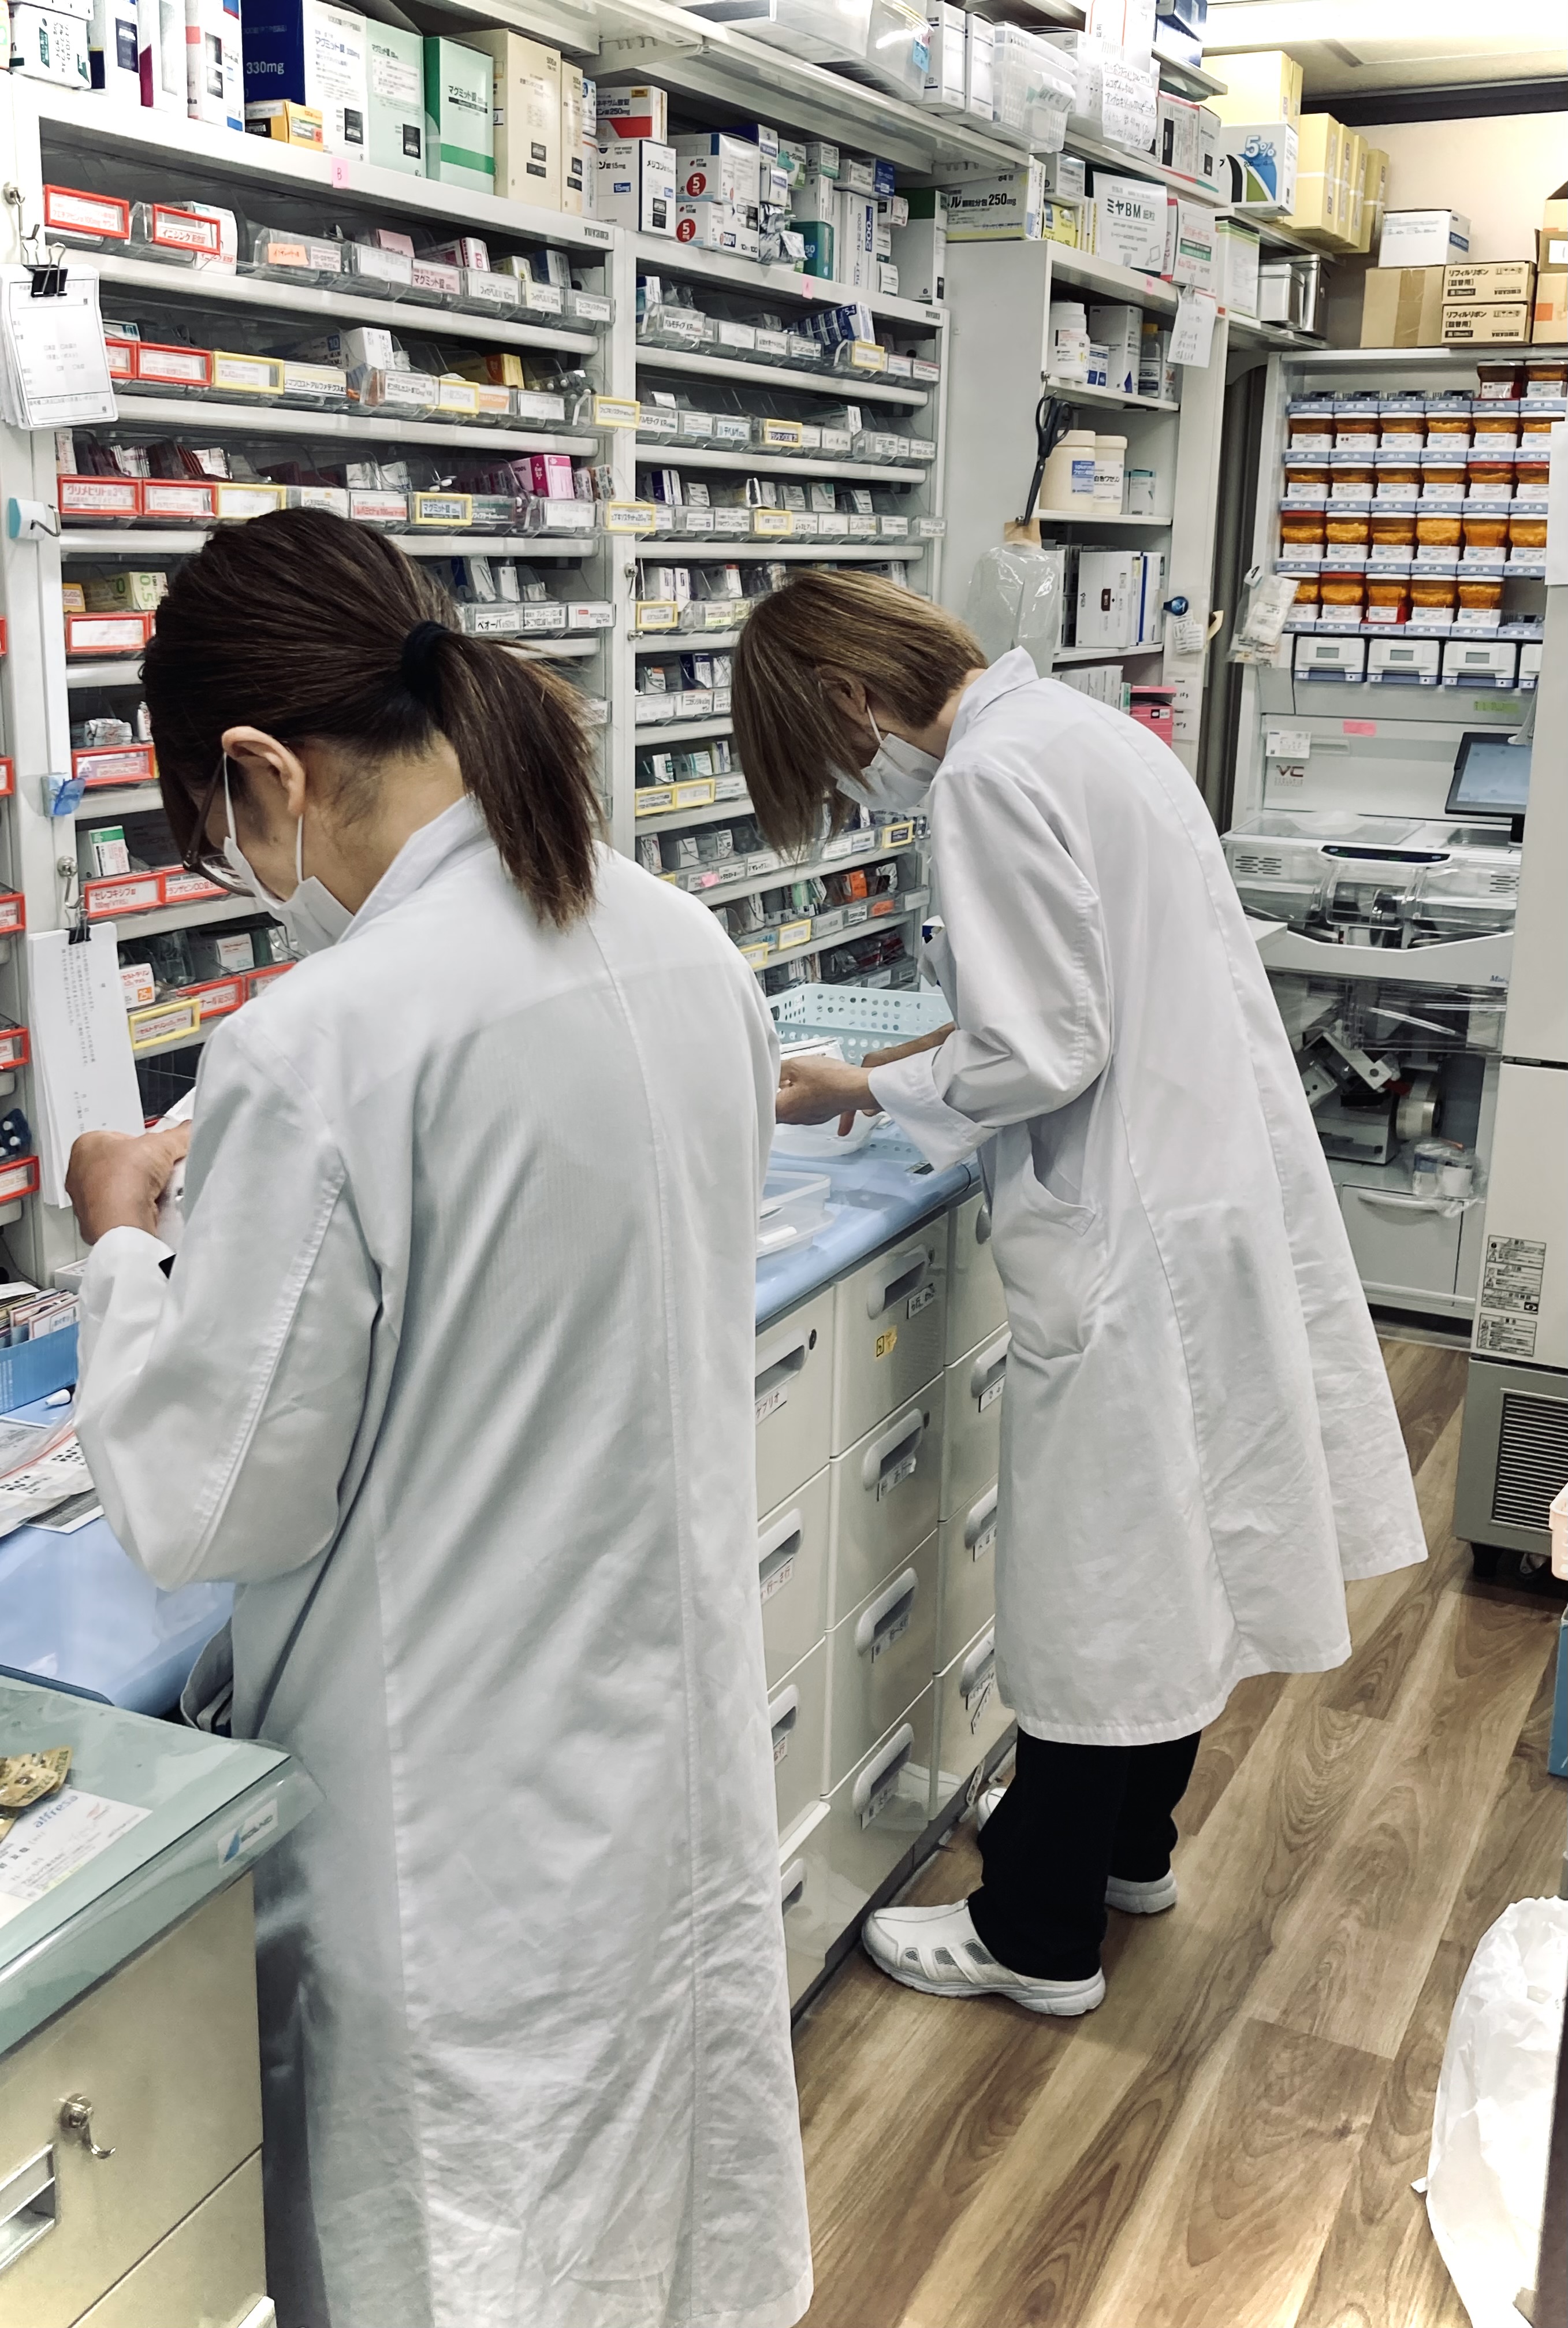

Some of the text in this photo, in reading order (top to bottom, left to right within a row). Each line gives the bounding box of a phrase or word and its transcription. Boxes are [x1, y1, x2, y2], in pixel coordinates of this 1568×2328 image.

[247, 61, 284, 75] 330mg
[448, 85, 476, 102] マグミット錠
[1245, 136, 1275, 157] 5%
[615, 184, 630, 192] 15mg
[989, 194, 1016, 206] 250mg
[1107, 198, 1141, 218] ミヤBM
[423, 503, 450, 514] マグミット錠
[1276, 765, 1304, 777] VC
[33, 1795, 79, 1828] alfresa
